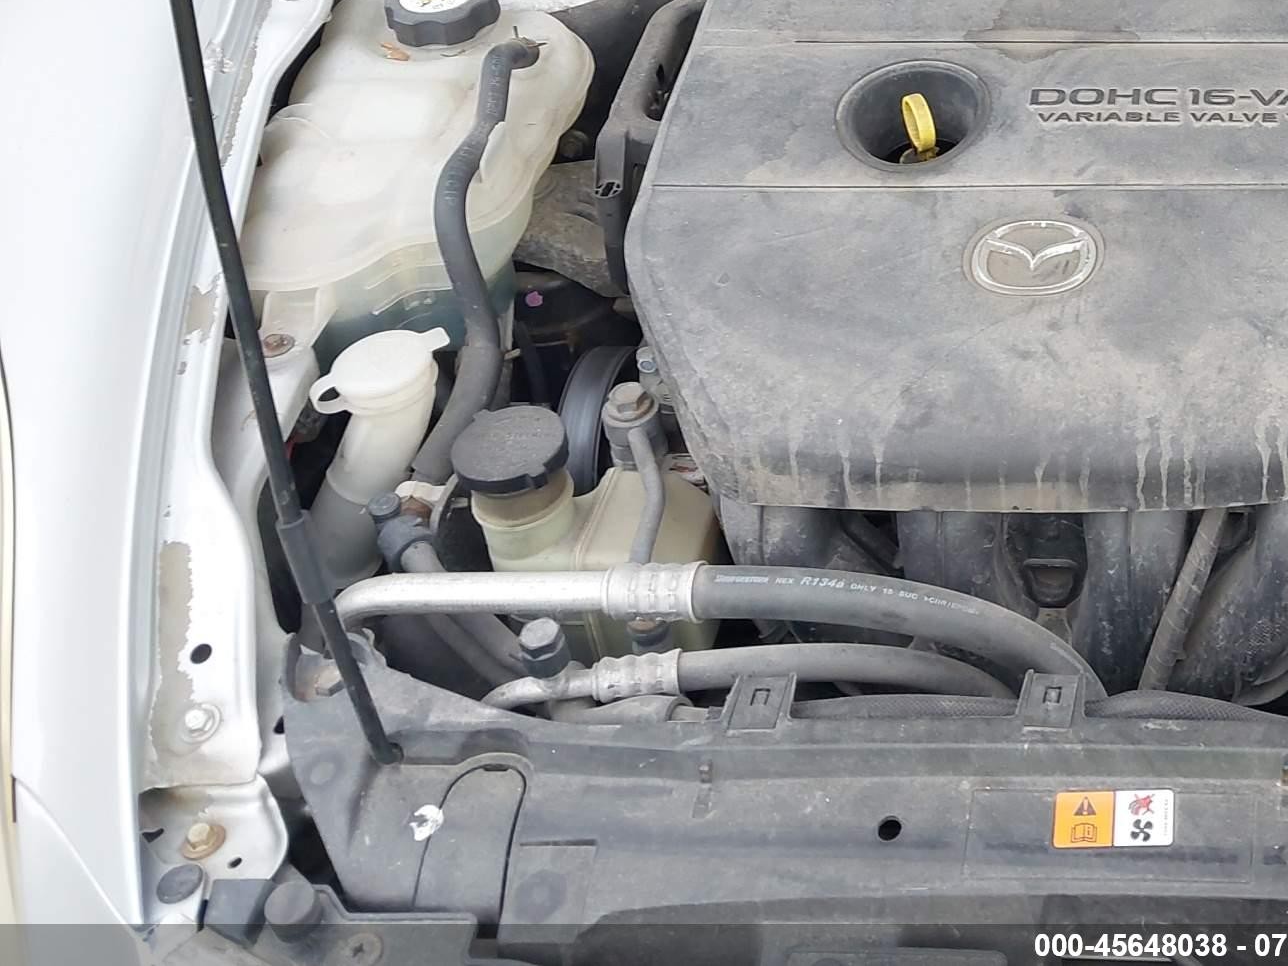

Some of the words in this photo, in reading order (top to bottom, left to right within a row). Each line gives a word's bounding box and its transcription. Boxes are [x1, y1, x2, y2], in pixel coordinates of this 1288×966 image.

[1029, 87, 1178, 107] DOHC
[1037, 111, 1181, 124] VARIABLE
[1190, 111, 1279, 124] VALVE
